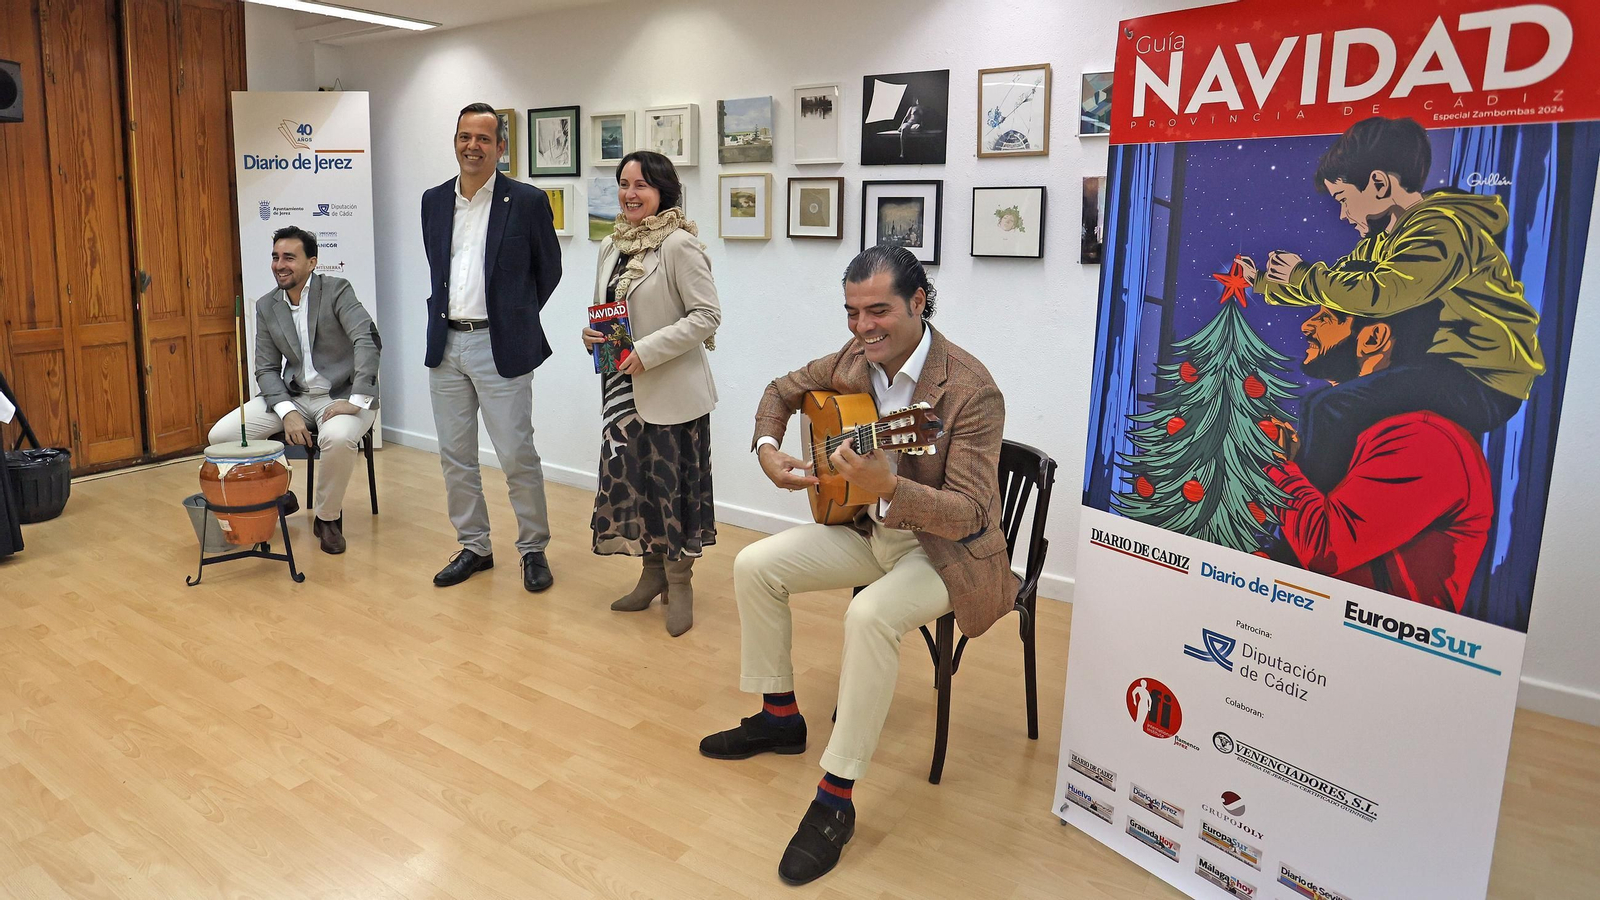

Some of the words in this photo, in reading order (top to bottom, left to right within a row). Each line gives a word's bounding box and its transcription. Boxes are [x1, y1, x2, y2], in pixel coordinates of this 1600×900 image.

[1135, 31, 1186, 55] Guía
[1132, 4, 1574, 118] NAVIDAD
[1130, 109, 1305, 129] PROVINCIA
[1343, 103, 1381, 117] DE
[1423, 90, 1564, 110] CÁDIZ
[1433, 112, 1471, 121] Especial
[1472, 107, 1536, 119] Zambombas
[1537, 105, 1564, 114] 2024
[296, 123, 313, 136] 40
[243, 154, 289, 170] Diario
[292, 153, 311, 170] de
[314, 154, 353, 174] Jerez
[331, 203, 357, 211] Diputación
[339, 209, 353, 217] Cádiz
[589, 305, 626, 318] NAVIDAD
[1091, 527, 1131, 552] DIARIO
[1133, 541, 1150, 556] DE
[1151, 546, 1190, 570] CADIZ
[1200, 561, 1246, 590] Diario
[1248, 576, 1269, 597] de
[1270, 584, 1315, 612] Jerez
[1235, 619, 1273, 640] Patrocina:
[1344, 600, 1482, 660] EuropaSur
[1241, 643, 1328, 688] Diputación
[1239, 664, 1259, 682] de
[1263, 674, 1309, 702] Cádiz
[1224, 696, 1265, 719] Colaboran:
[1071, 753, 1090, 768] DIARIO
[1089, 763, 1098, 772] DE
[1067, 783, 1092, 802] Huelva
[1236, 743, 1349, 805] VENENCIADORES,
[1351, 797, 1378, 817] S.L.
[1133, 785, 1152, 802] Diario
[1160, 802, 1178, 816] Jerez
[1129, 819, 1159, 841] Granada
[1159, 835, 1174, 849] Hoy
[1202, 822, 1248, 852] EuropaSur
[1198, 858, 1230, 885] Málaga
[1235, 879, 1254, 895] hoy
[1280, 866, 1307, 886] Diario
[1306, 881, 1319, 891] de
